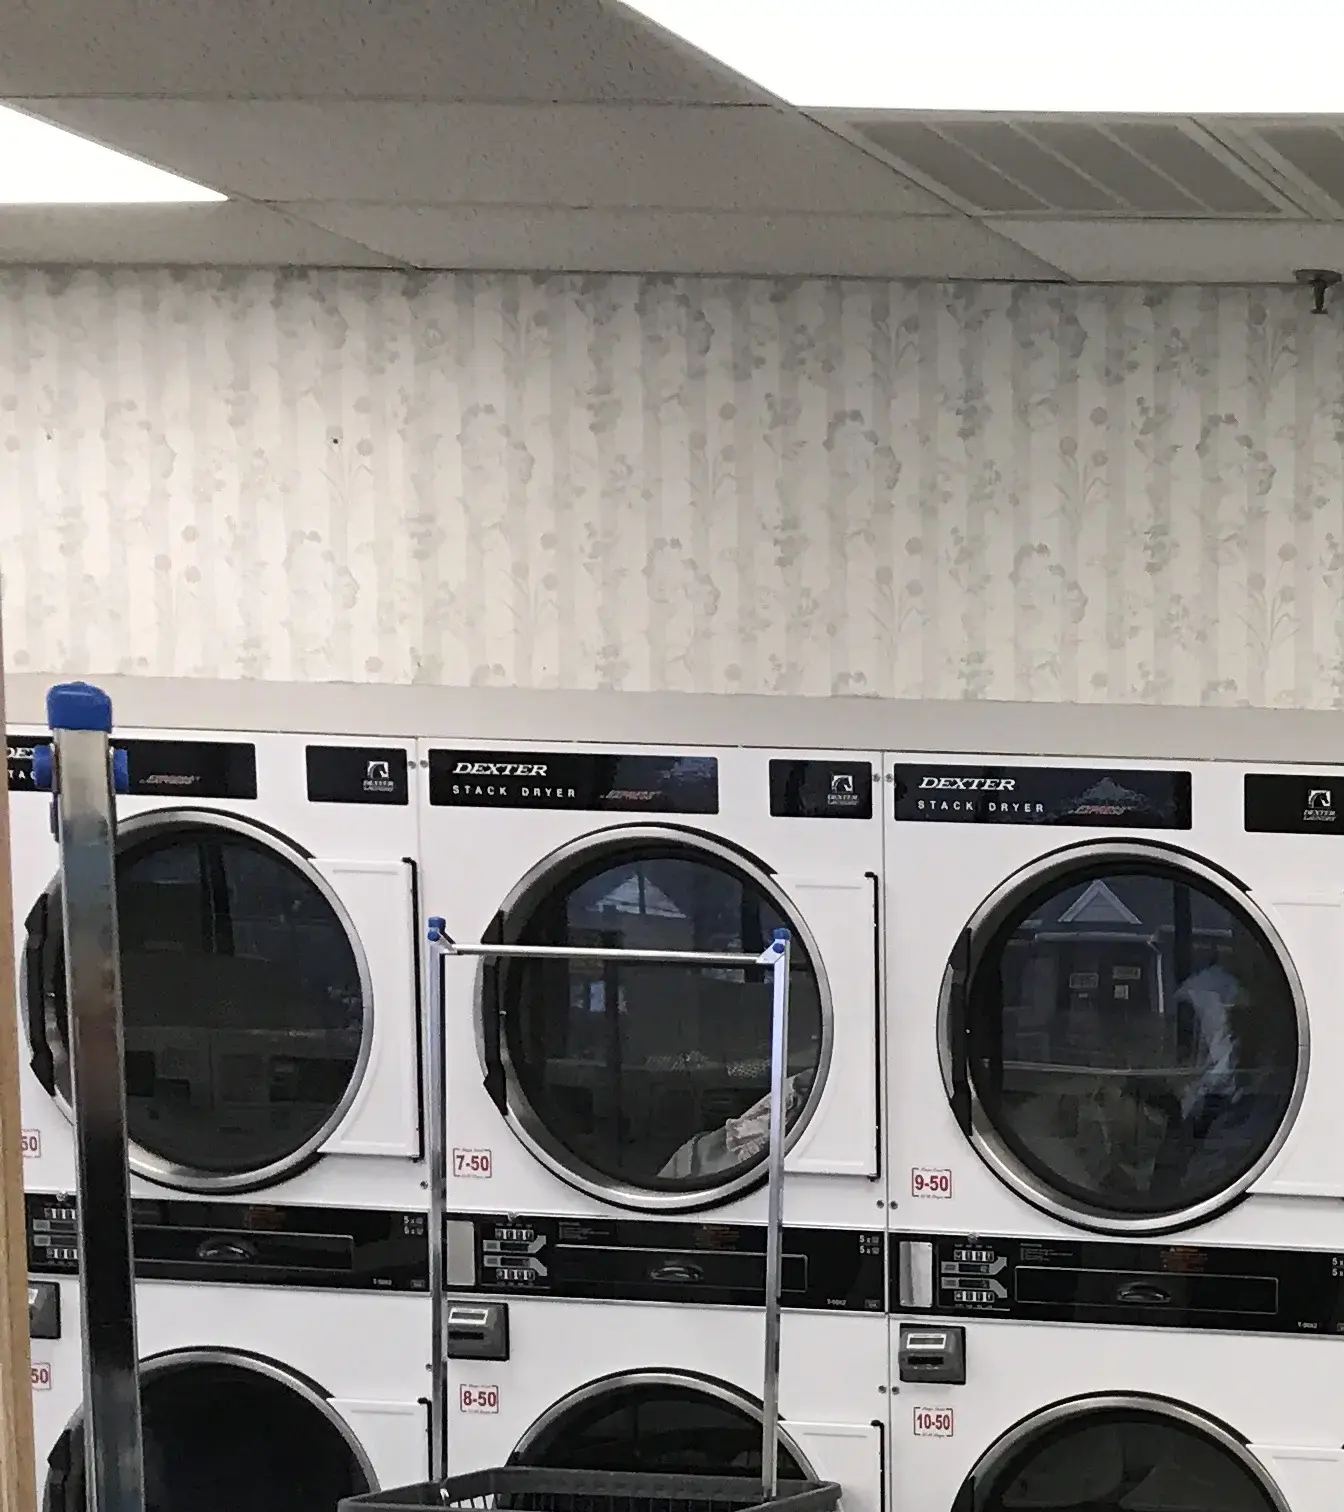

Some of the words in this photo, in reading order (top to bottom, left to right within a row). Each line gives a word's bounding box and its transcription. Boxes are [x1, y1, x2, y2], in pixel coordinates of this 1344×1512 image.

[453, 762, 548, 776] DEXTER
[919, 777, 1016, 790] DEXTER
[453, 785, 507, 796] STACK
[522, 786, 575, 798] DRYER
[918, 800, 973, 811] STACK
[989, 802, 1043, 813] DRYER
[456, 1155, 489, 1171] 7-50
[915, 1174, 949, 1191] 9-50
[463, 1391, 497, 1407] 8-50
[916, 1413, 951, 1430] 10-50
